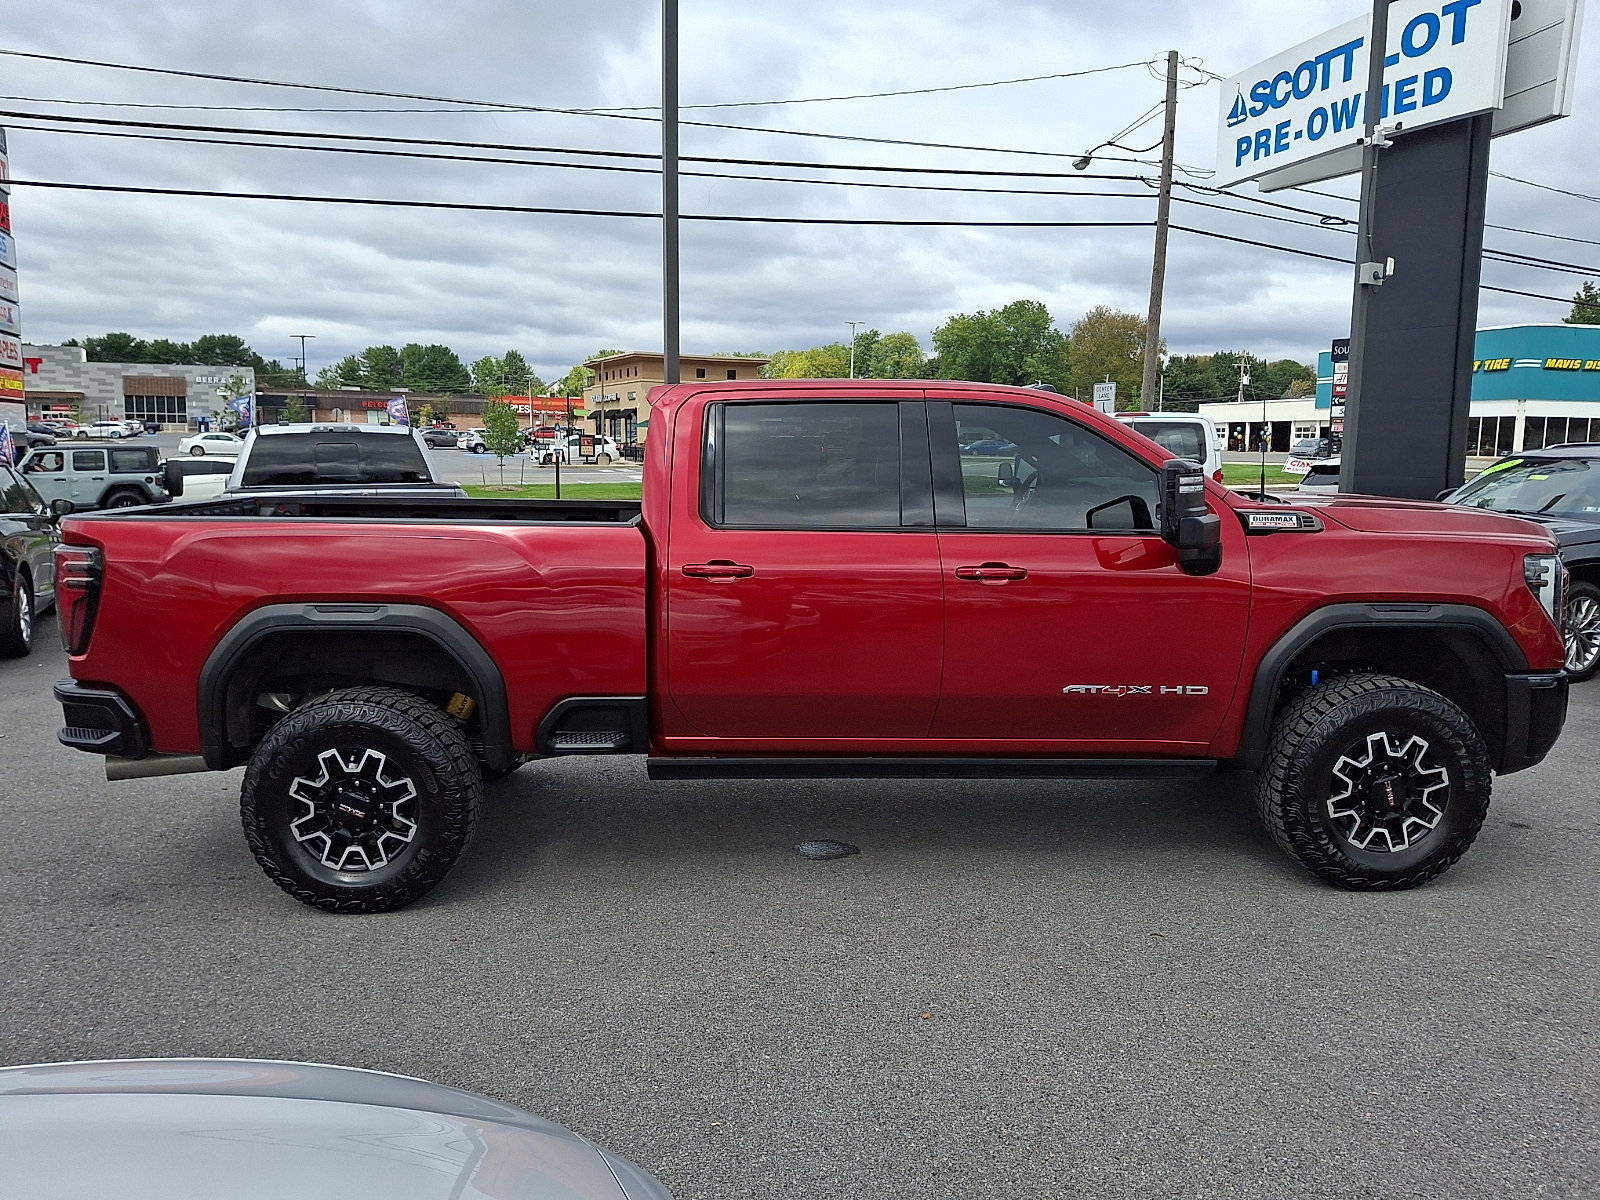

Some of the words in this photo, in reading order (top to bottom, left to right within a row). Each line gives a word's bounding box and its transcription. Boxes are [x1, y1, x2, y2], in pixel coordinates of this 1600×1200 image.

[1249, 37, 1364, 118] SCOTT
[1483, 358, 1511, 371] TIRE
[1545, 358, 1582, 369] MAVIS
[195, 376, 219, 384] BEER
[228, 377, 252, 385] WE
[1096, 385, 1113, 393] CENTER
[1062, 684, 1152, 697] AT4X
[1160, 685, 1209, 695] HD
